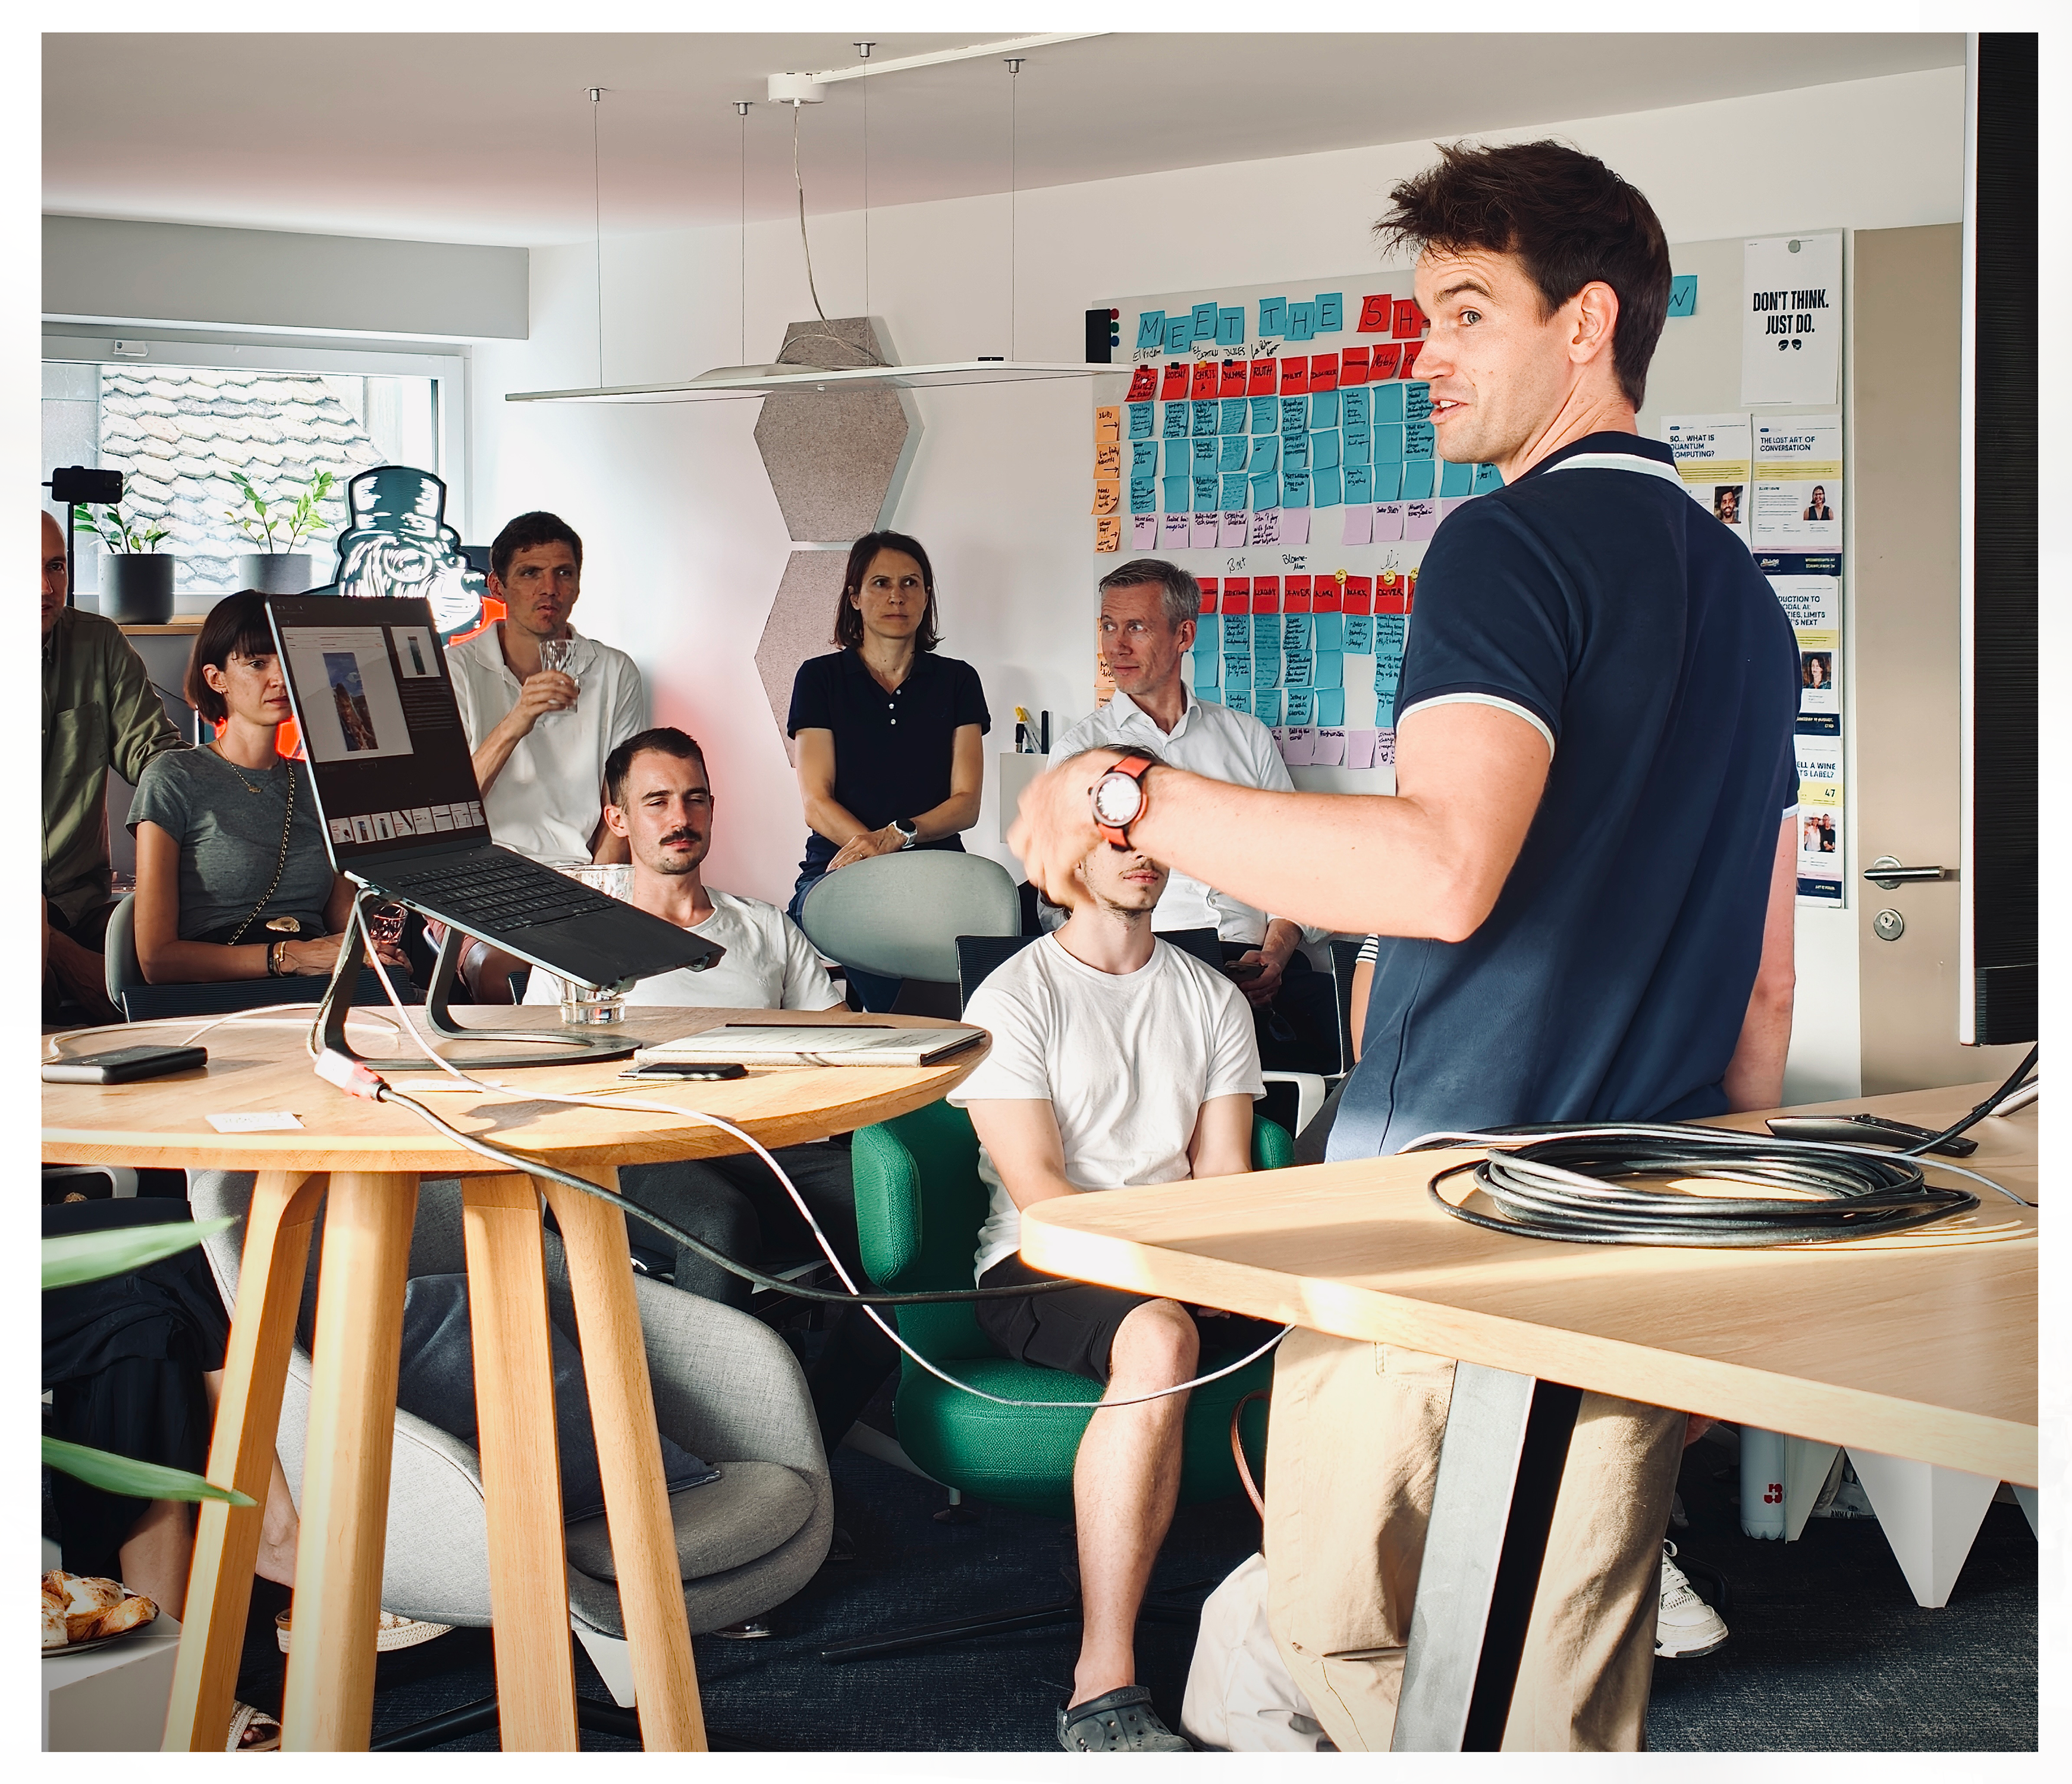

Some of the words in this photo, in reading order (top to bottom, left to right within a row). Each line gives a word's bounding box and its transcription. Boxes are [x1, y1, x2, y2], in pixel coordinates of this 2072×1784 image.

[1753, 290, 1788, 312] DON'T
[1791, 288, 1829, 310] THINK.
[1139, 310, 1239, 348] MEET
[1264, 303, 1336, 335] THE
[1765, 314, 1794, 335] JUST
[1795, 313, 1815, 334] DO.
[1760, 444, 1811, 452] CONVERSATION
[1817, 762, 1836, 770] WINE
[1810, 769, 1835, 778] LABEL?
[1825, 788, 1836, 797] 47
